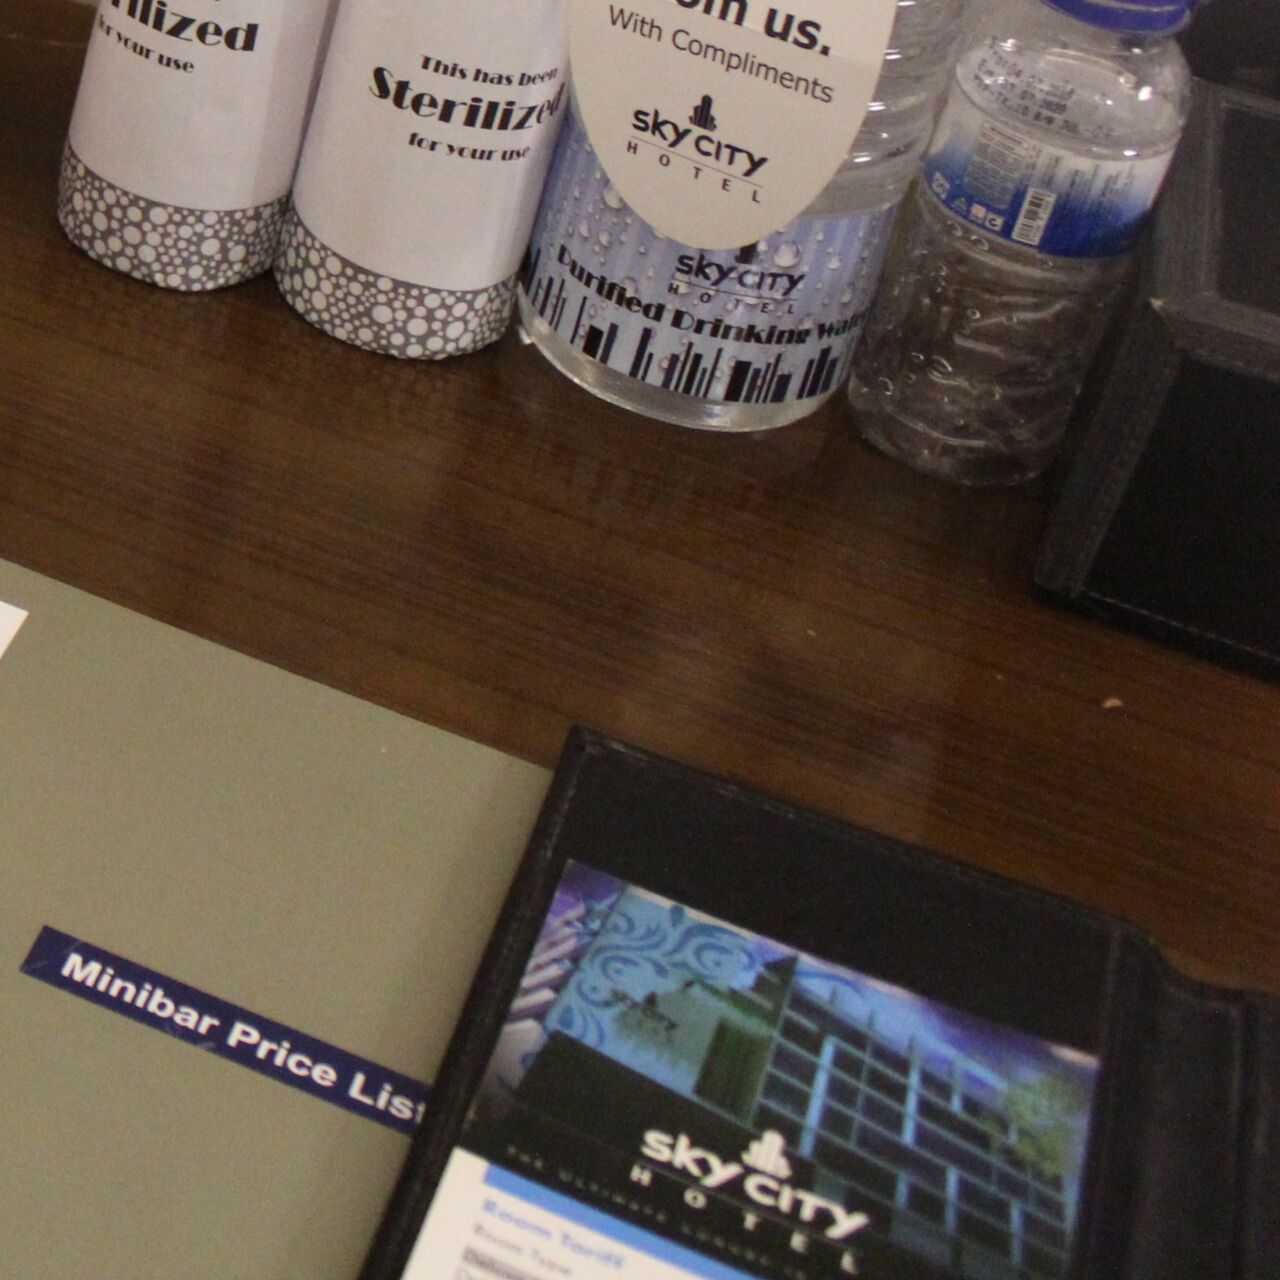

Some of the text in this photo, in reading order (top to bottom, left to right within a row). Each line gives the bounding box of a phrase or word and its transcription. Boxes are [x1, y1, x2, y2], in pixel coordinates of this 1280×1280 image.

[117, 31, 157, 60] your
[157, 53, 196, 74] use
[609, 4, 835, 104] With Compliments
[763, 8, 831, 58] us.
[369, 66, 566, 131] Sterilized
[421, 53, 559, 87] This has been
[408, 132, 531, 162] for your use
[627, 140, 761, 204] HOTEL
[557, 243, 667, 323] Purified
[670, 308, 811, 346] Drinking
[60, 951, 221, 1036] Minibar
[226, 1020, 339, 1089] Price
